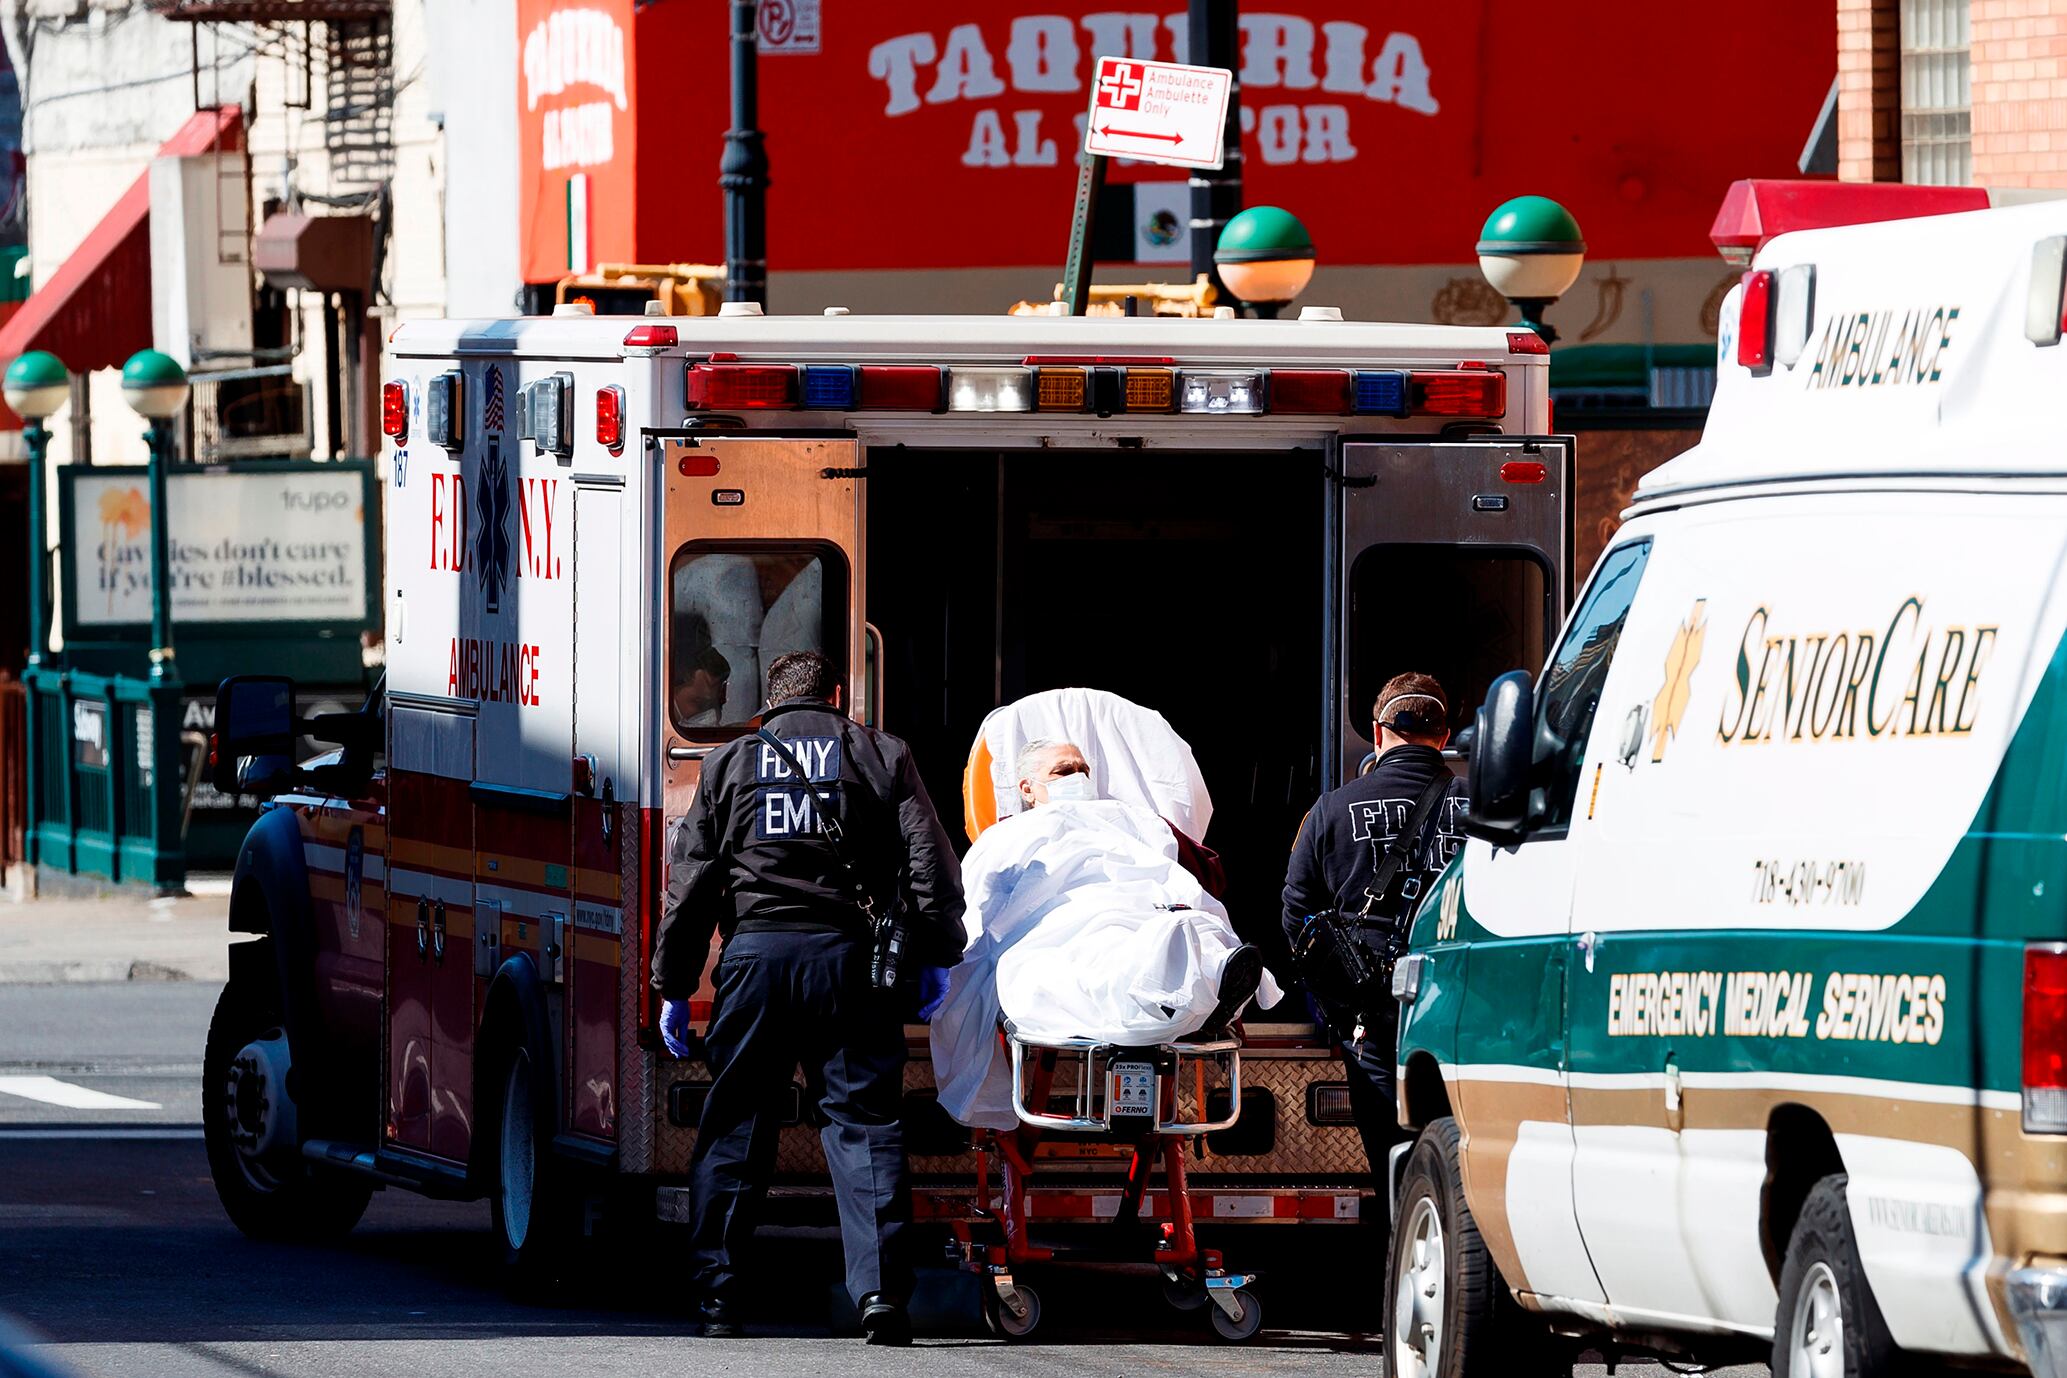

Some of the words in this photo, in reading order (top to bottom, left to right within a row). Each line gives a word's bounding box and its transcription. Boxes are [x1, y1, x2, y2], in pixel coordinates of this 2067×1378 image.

[1147, 86, 1209, 105] Ambulette
[1149, 71, 1214, 90] Ambulance
[1144, 101, 1170, 118] Only
[961, 109, 1058, 166] AL
[1805, 305, 1960, 389] AMBULANCE
[393, 450, 408, 488] 187
[283, 488, 348, 511] trupo
[448, 637, 540, 706] AMBULANCE
[761, 740, 835, 779] FDNY
[1608, 971, 1723, 1037] EMERGENCY
[1723, 971, 1813, 1038] MEDICAL
[1815, 971, 1947, 1045] SERVICES
[1122, 1106, 1148, 1114] FERNO
